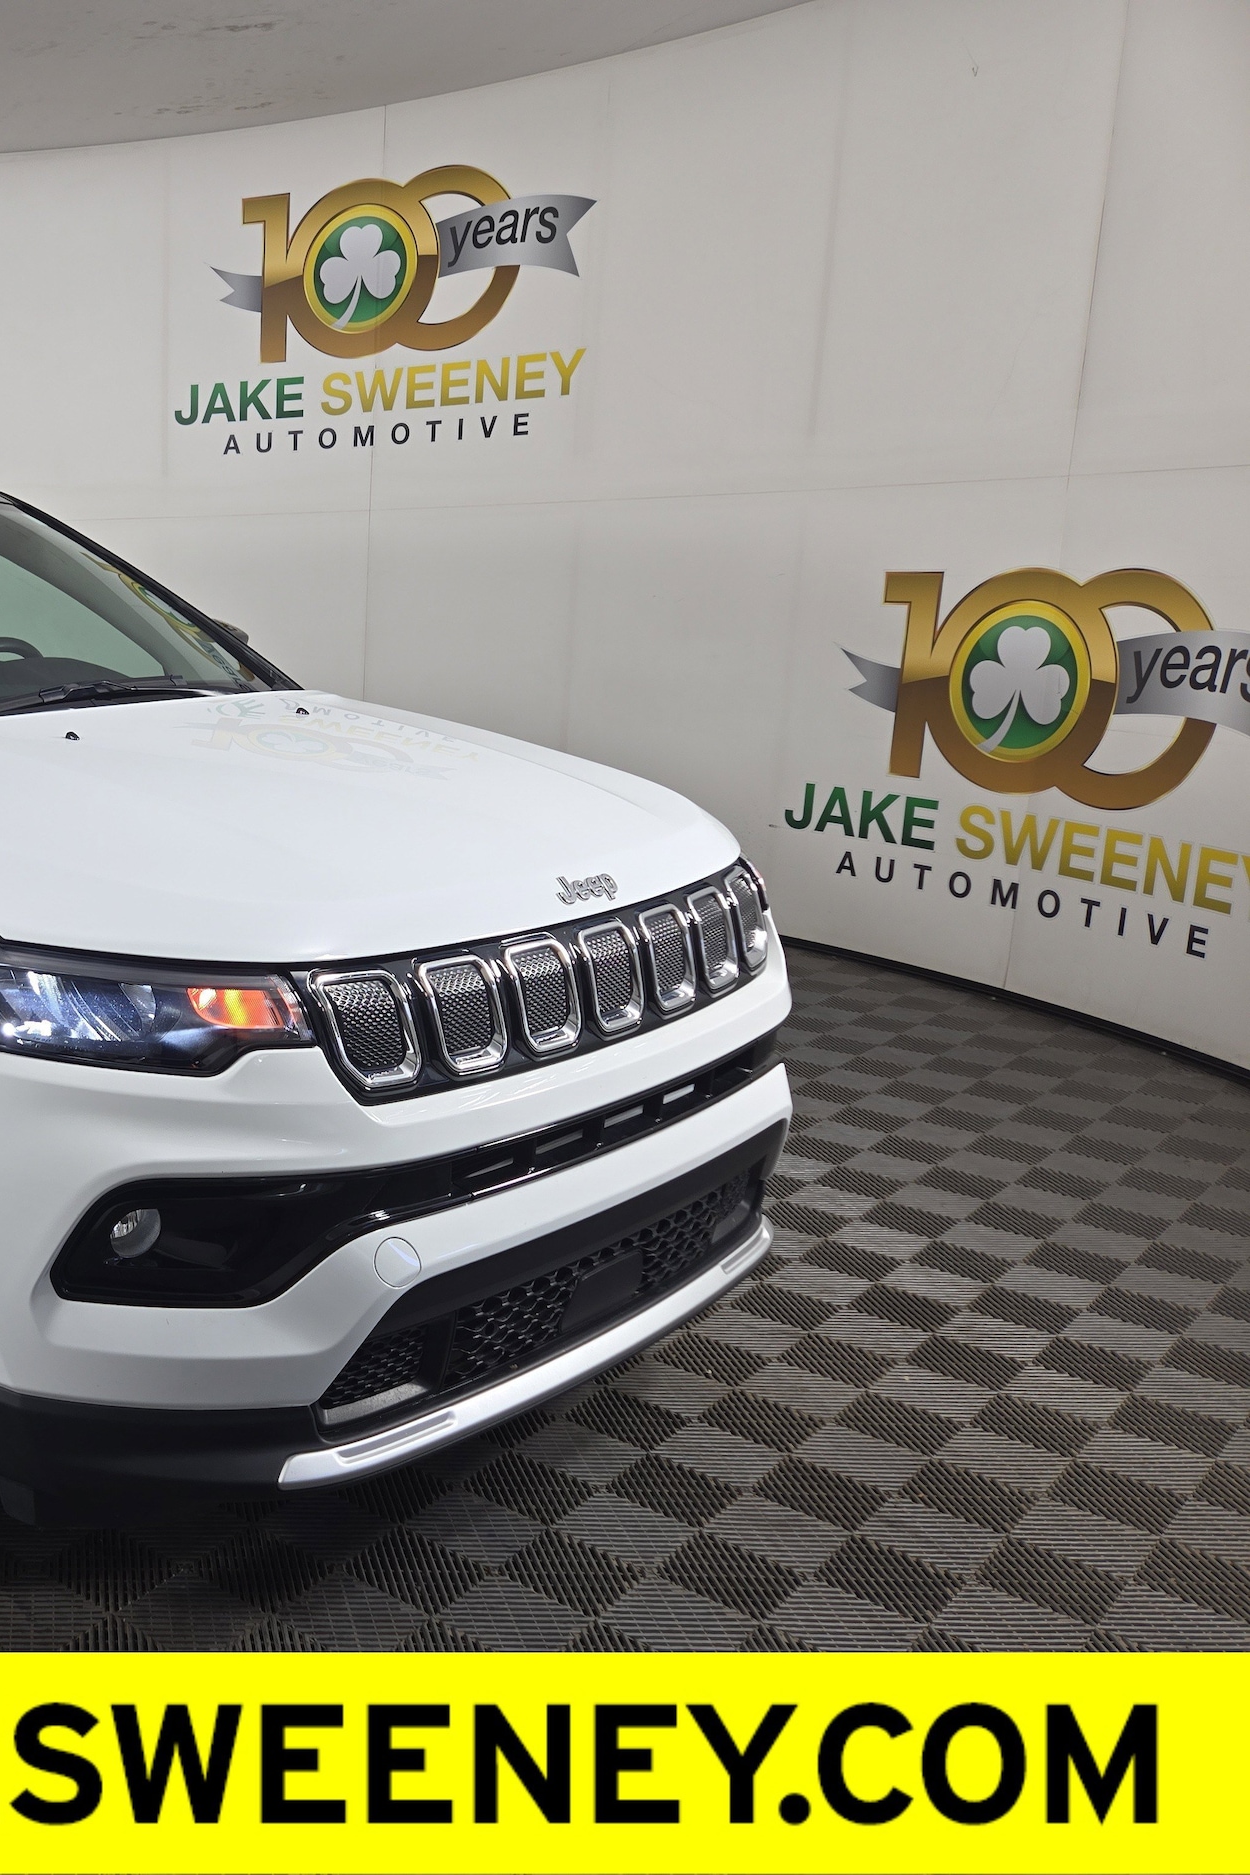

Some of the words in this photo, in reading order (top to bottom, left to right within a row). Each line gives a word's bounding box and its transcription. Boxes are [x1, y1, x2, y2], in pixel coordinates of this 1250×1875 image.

[241, 164, 521, 364] 100
[447, 204, 560, 269] years
[174, 375, 305, 426] JAKE
[320, 348, 587, 417] SWEENEY
[223, 412, 530, 455] AUTOMOTIVE
[882, 567, 1218, 811] 100
[784, 782, 940, 851] JAKE
[555, 873, 619, 905] Jeep
[835, 850, 1209, 960] AUTOMOTIVE
